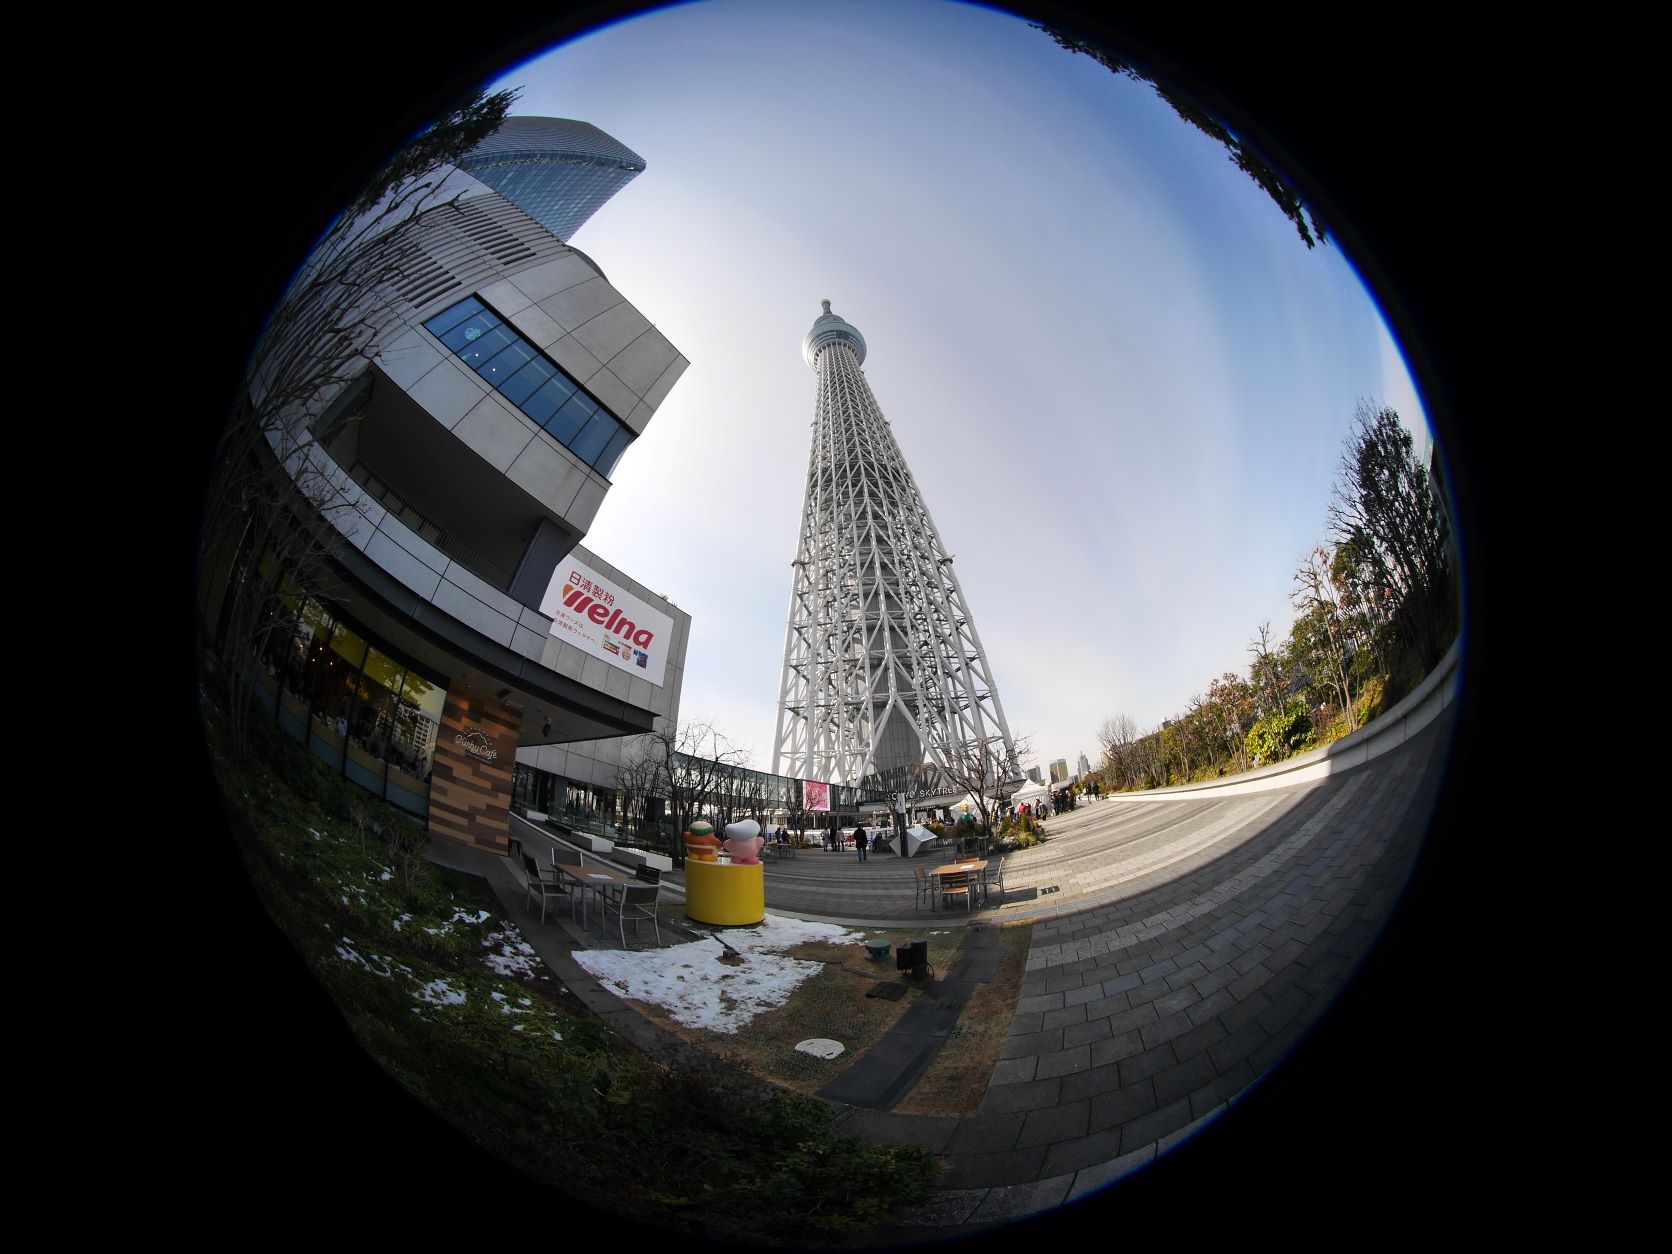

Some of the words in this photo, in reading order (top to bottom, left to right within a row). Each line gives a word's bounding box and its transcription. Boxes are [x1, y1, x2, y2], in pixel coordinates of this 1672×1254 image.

[569, 571, 615, 606] 日清製粉
[919, 786, 957, 797] SKYTREE
